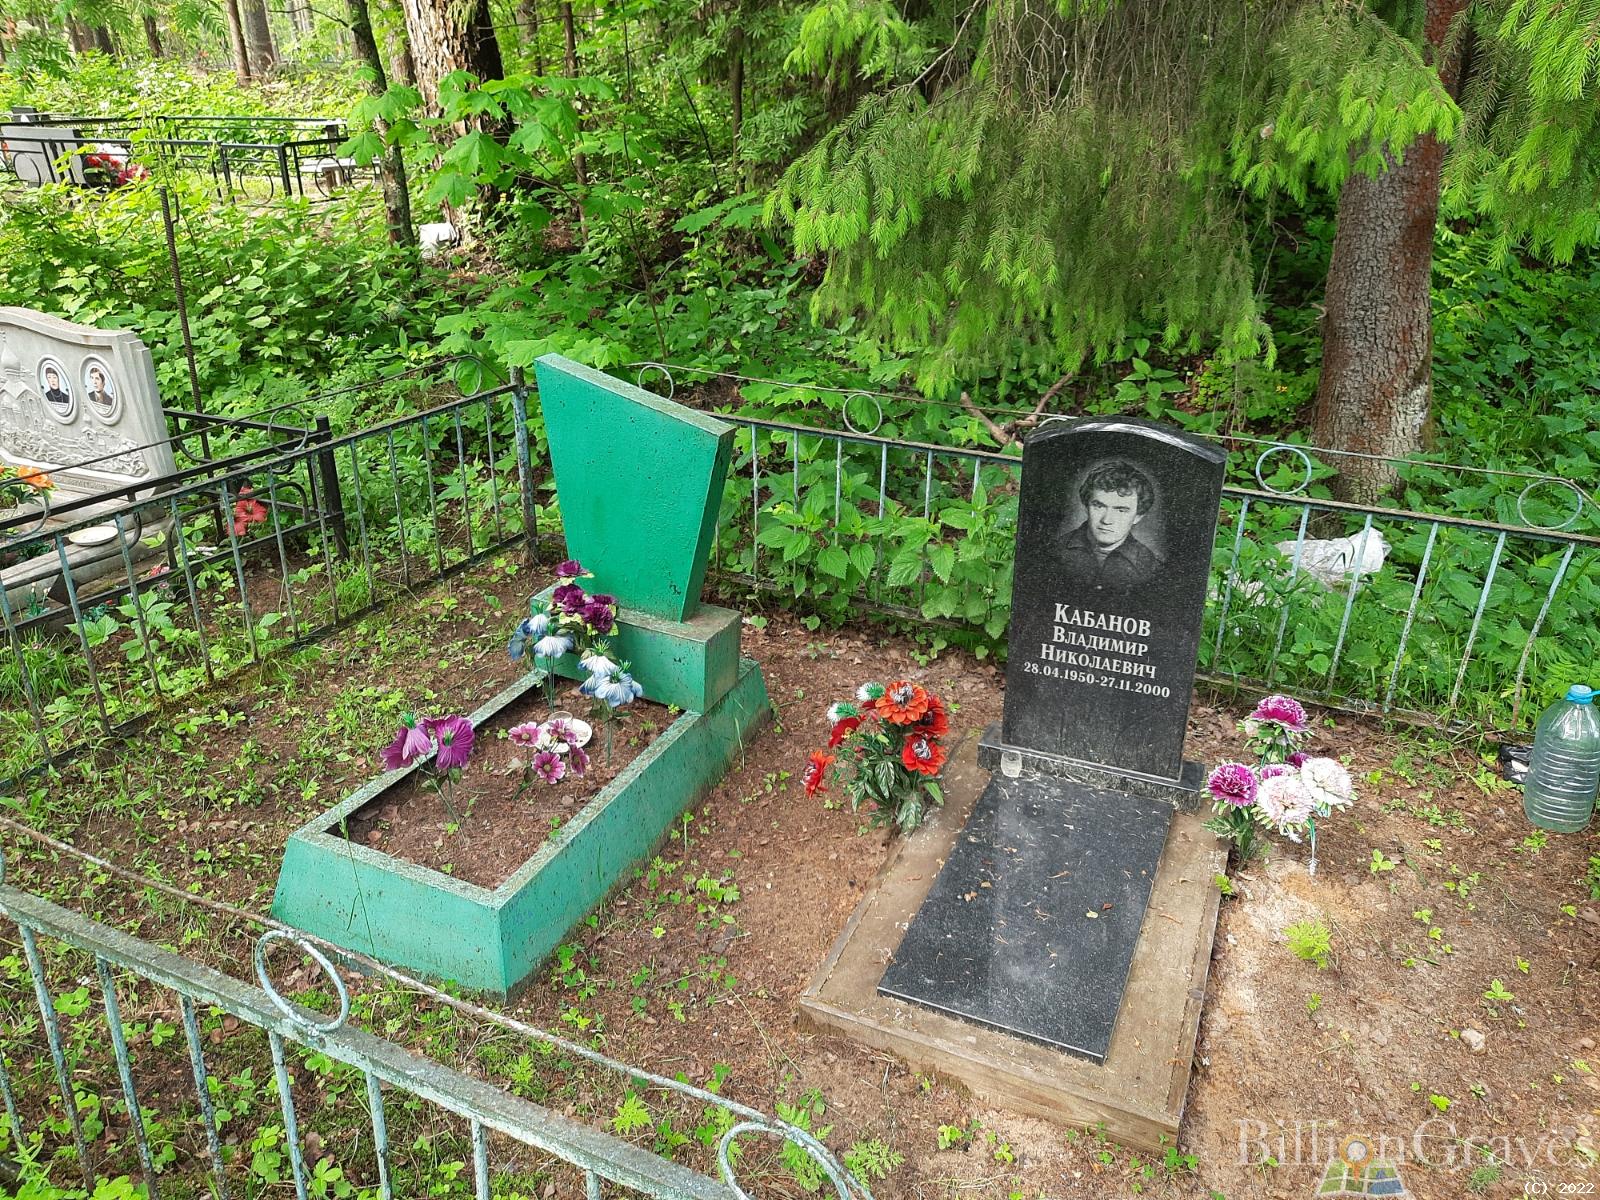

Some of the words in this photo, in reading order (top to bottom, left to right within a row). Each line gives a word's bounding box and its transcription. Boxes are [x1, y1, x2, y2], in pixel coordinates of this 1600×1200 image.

[1053, 602, 1151, 637] КАБАНОВ
[1052, 625, 1149, 657] ВЛАДИМИР
[1040, 643, 1157, 679] НИКОЛАЕВИЧ
